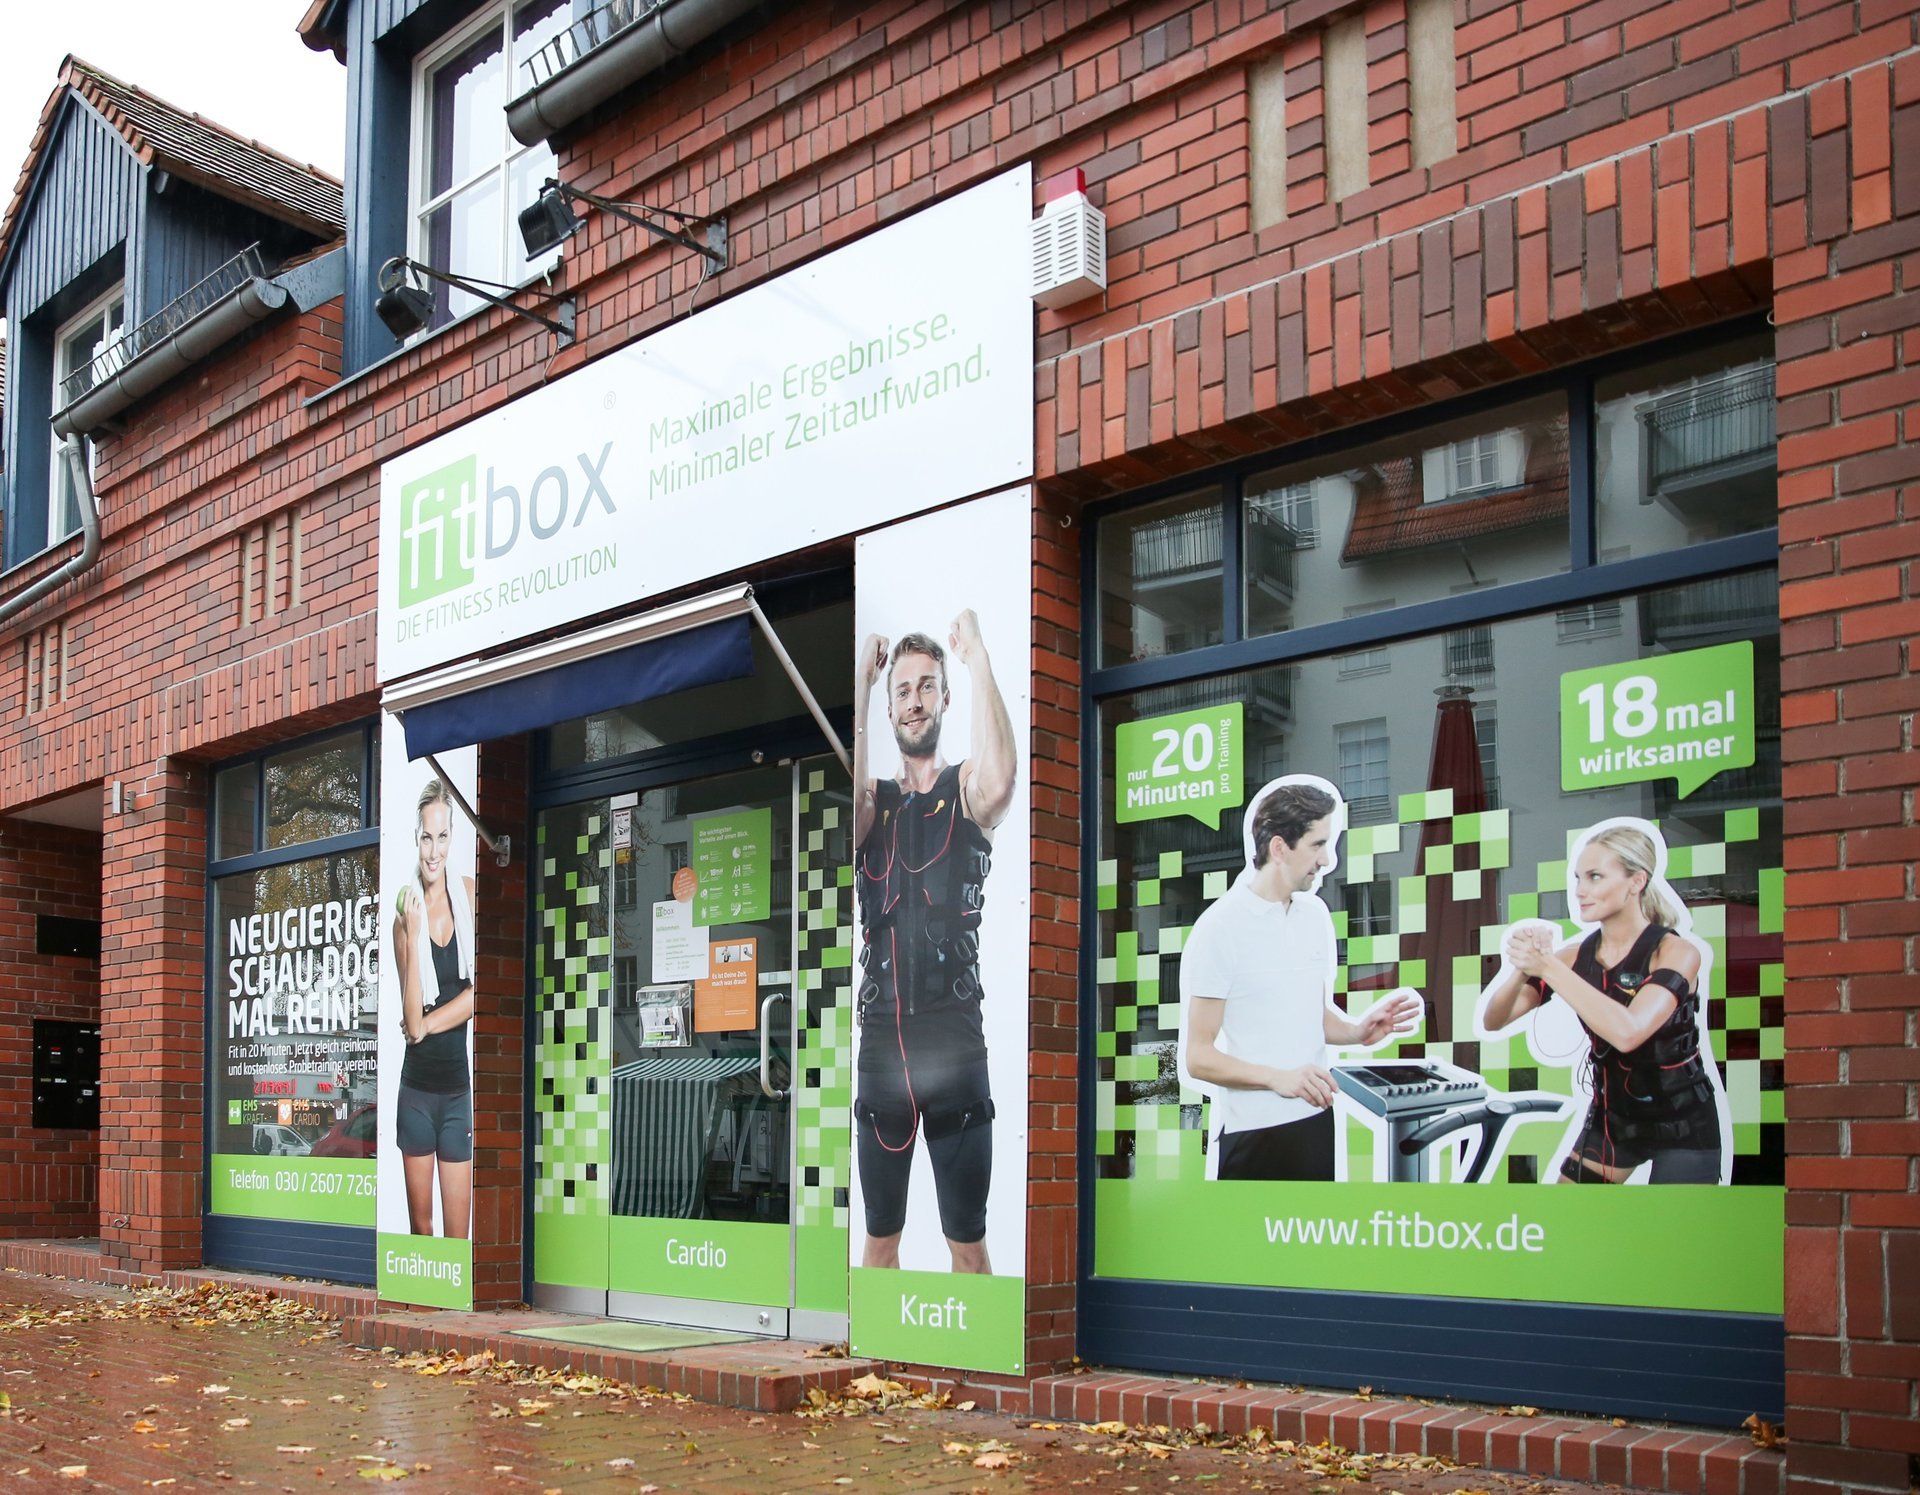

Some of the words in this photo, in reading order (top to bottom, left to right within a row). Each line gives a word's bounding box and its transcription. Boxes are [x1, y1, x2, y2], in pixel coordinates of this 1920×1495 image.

[649, 381, 772, 453] Maximale
[783, 311, 957, 397] Ergebnisse.
[649, 430, 775, 500] Minimaler
[785, 343, 991, 450] Zeitaufwand.
[402, 441, 617, 590] fitbox
[397, 613, 421, 643] DIE
[427, 588, 493, 633] FITNESS
[498, 543, 617, 607] REVOLUTION
[1578, 675, 1658, 743] 18
[1666, 689, 1735, 731] mal
[1127, 769, 1148, 782] nur
[1152, 723, 1213, 777] 20
[1217, 718, 1232, 771] Training
[1579, 735, 1735, 775] wirksamer
[1127, 779, 1214, 808] Minuten
[1220, 773, 1231, 794] pro
[229, 949, 313, 998] SCHAU
[229, 998, 279, 1039] MAL
[287, 987, 359, 1035] REIN!
[228, 1045, 238, 1058] Fit
[240, 1044, 247, 1058] in
[249, 1044, 259, 1057] 20
[260, 1042, 293, 1056] Minuten.
[294, 1041, 313, 1058] Jetzt
[315, 1039, 339, 1056] gleich
[228, 1062, 242, 1076] und
[244, 1060, 287, 1075] kostenloses
[289, 1057, 342, 1075] Probetraining
[345, 1056, 377, 1071] vereinb
[243, 1100, 258, 1111] EMS
[293, 1099, 310, 1111] EMS
[243, 1113, 264, 1125] KRAFT
[293, 1112, 320, 1126] CARDIO
[229, 1169, 269, 1190] Telefon
[275, 1171, 299, 1191] 030
[301, 1173, 307, 1192] /
[310, 1172, 343, 1194] 2607
[1264, 1210, 1545, 1252] www.fitbox.de
[386, 1250, 462, 1287] Ernährung
[665, 1237, 727, 1269] Cardio
[900, 1293, 967, 1331] Kraft
